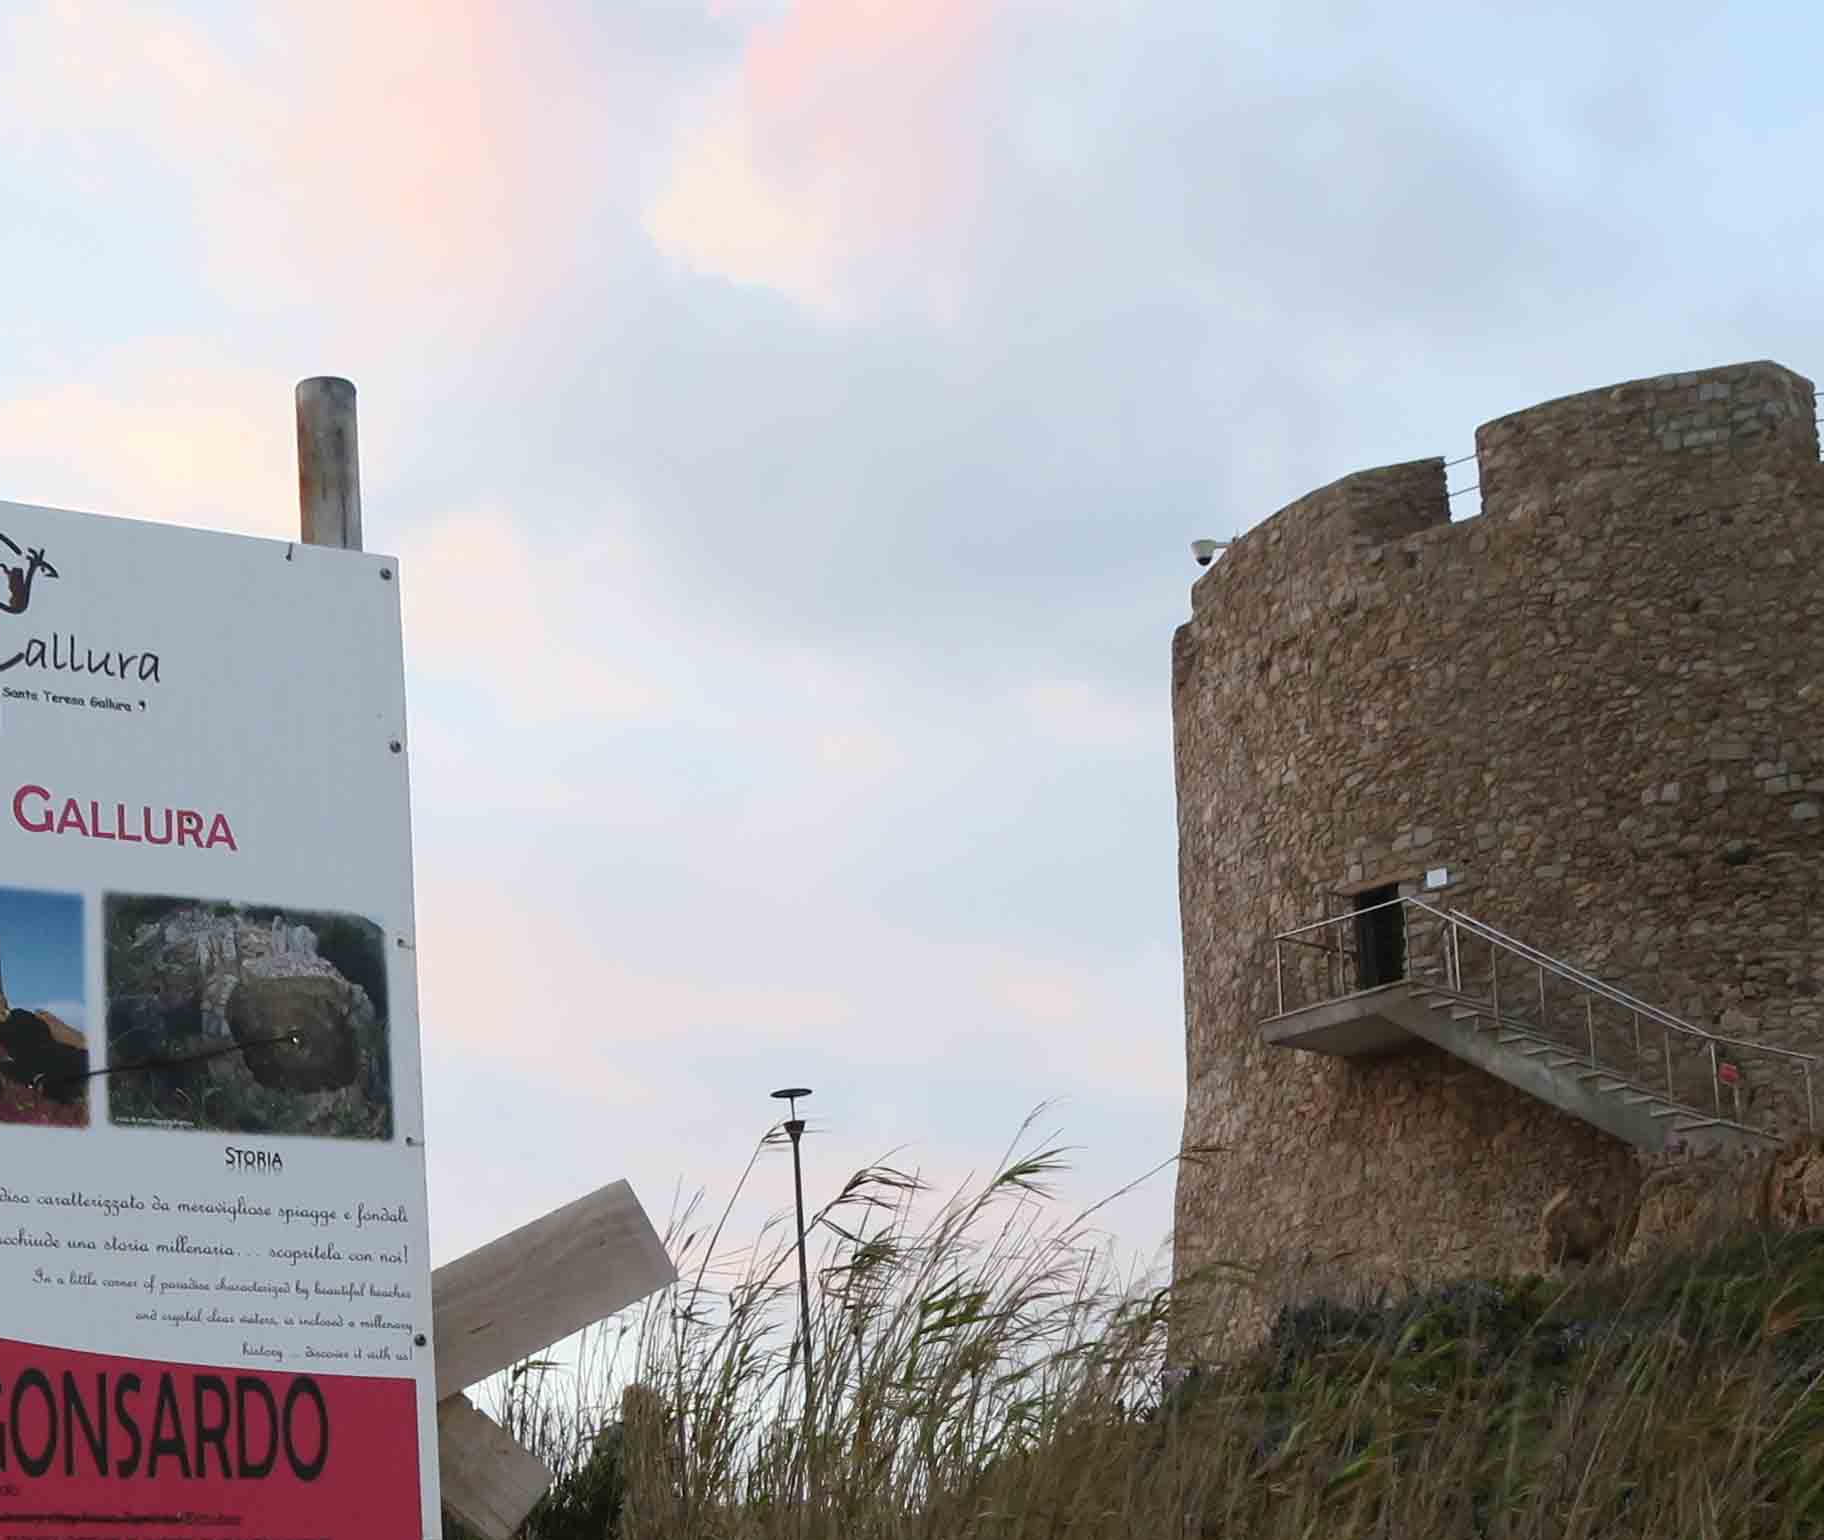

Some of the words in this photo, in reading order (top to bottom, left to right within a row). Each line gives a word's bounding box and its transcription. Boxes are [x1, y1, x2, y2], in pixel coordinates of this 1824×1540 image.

[2, 686, 38, 702] Santa
[45, 690, 85, 708] Teresa
[90, 696, 133, 713] Gallura
[37, 1192, 145, 1217] caratterizzato
[152, 1195, 171, 1211] da
[178, 1196, 272, 1224] meravigliose
[278, 1206, 337, 1227] spiagge
[344, 1212, 353, 1221] e
[357, 1203, 409, 1229] fondali
[67, 1239, 97, 1251] una
[104, 1236, 149, 1253] storia
[270, 1242, 343, 1266] scopritela
[348, 1253, 373, 1263] con
[380, 1245, 409, 1265] noi!
[69, 1270, 98, 1287] little
[144, 1274, 156, 1294] of
[160, 1277, 211, 1296] paradise
[295, 1280, 309, 1300] by
[314, 1280, 365, 1302] beautiful
